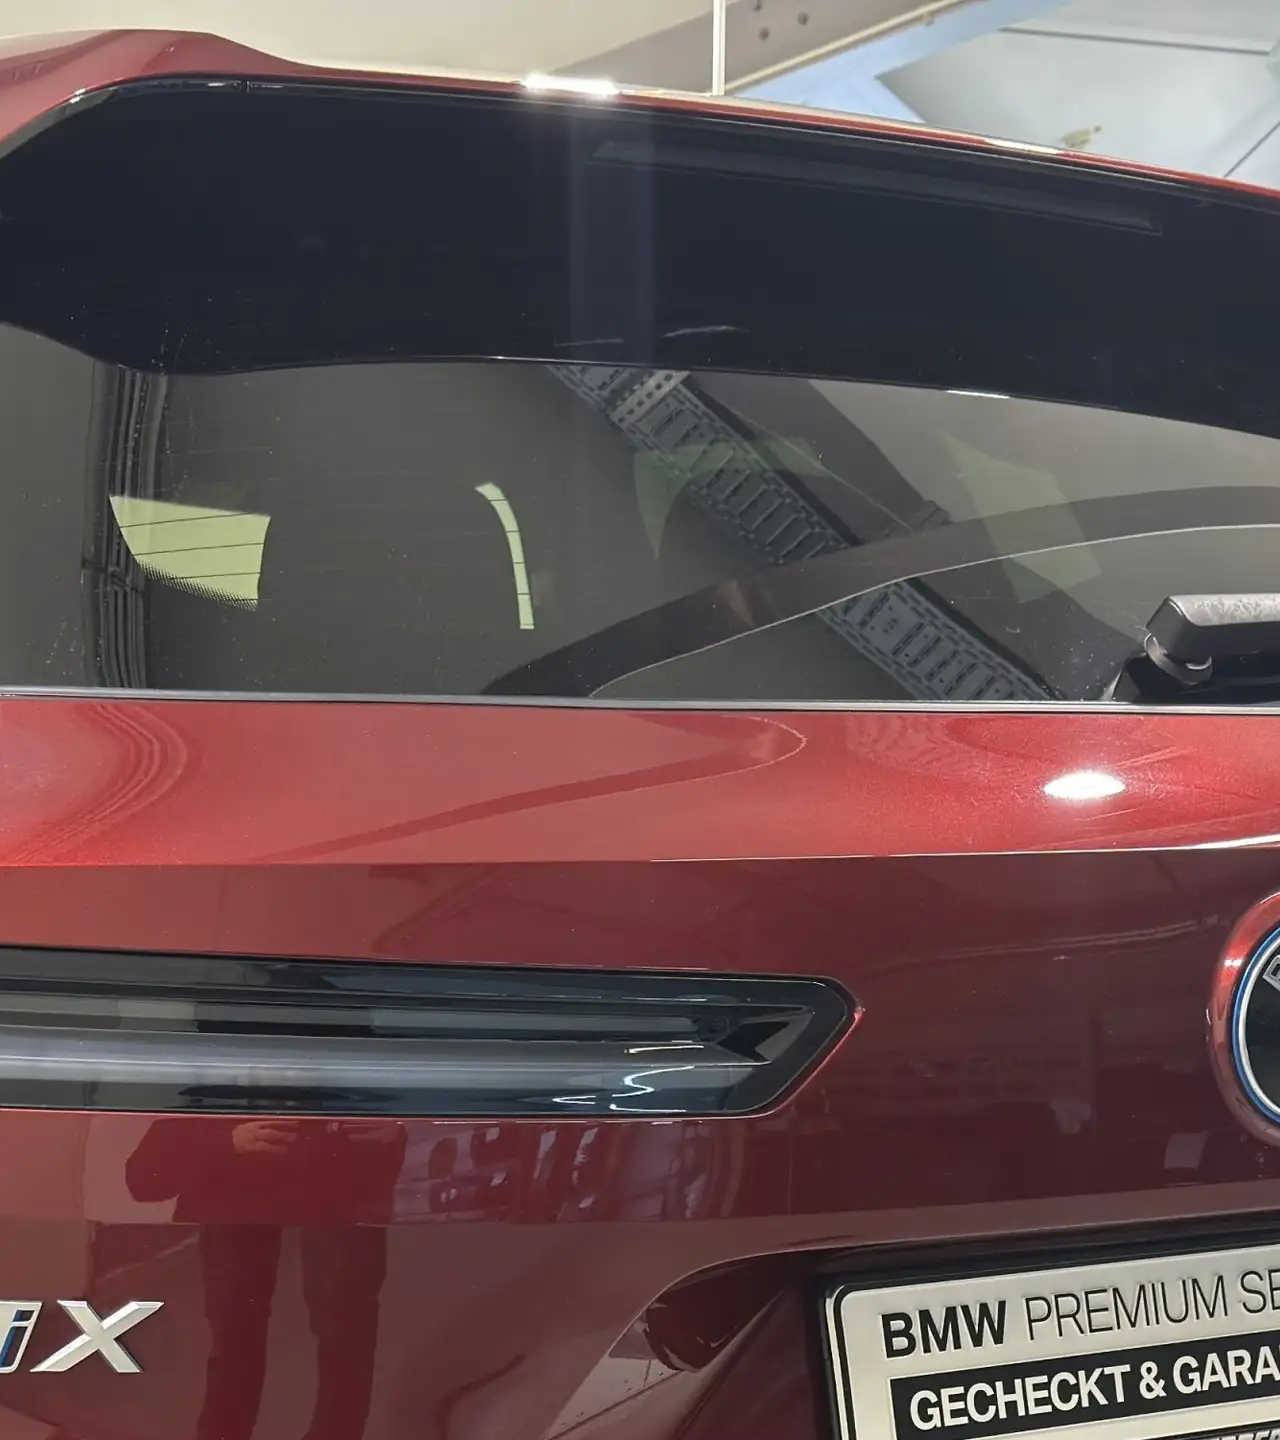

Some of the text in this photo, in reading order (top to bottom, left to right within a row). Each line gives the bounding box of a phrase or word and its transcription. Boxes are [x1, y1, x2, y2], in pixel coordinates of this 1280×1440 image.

[881, 1299, 1007, 1359] BMW
[1024, 1275, 1228, 1341] PREMIUM
[909, 1364, 1131, 1431] GECHECKT
[1138, 1360, 1167, 1400] &
